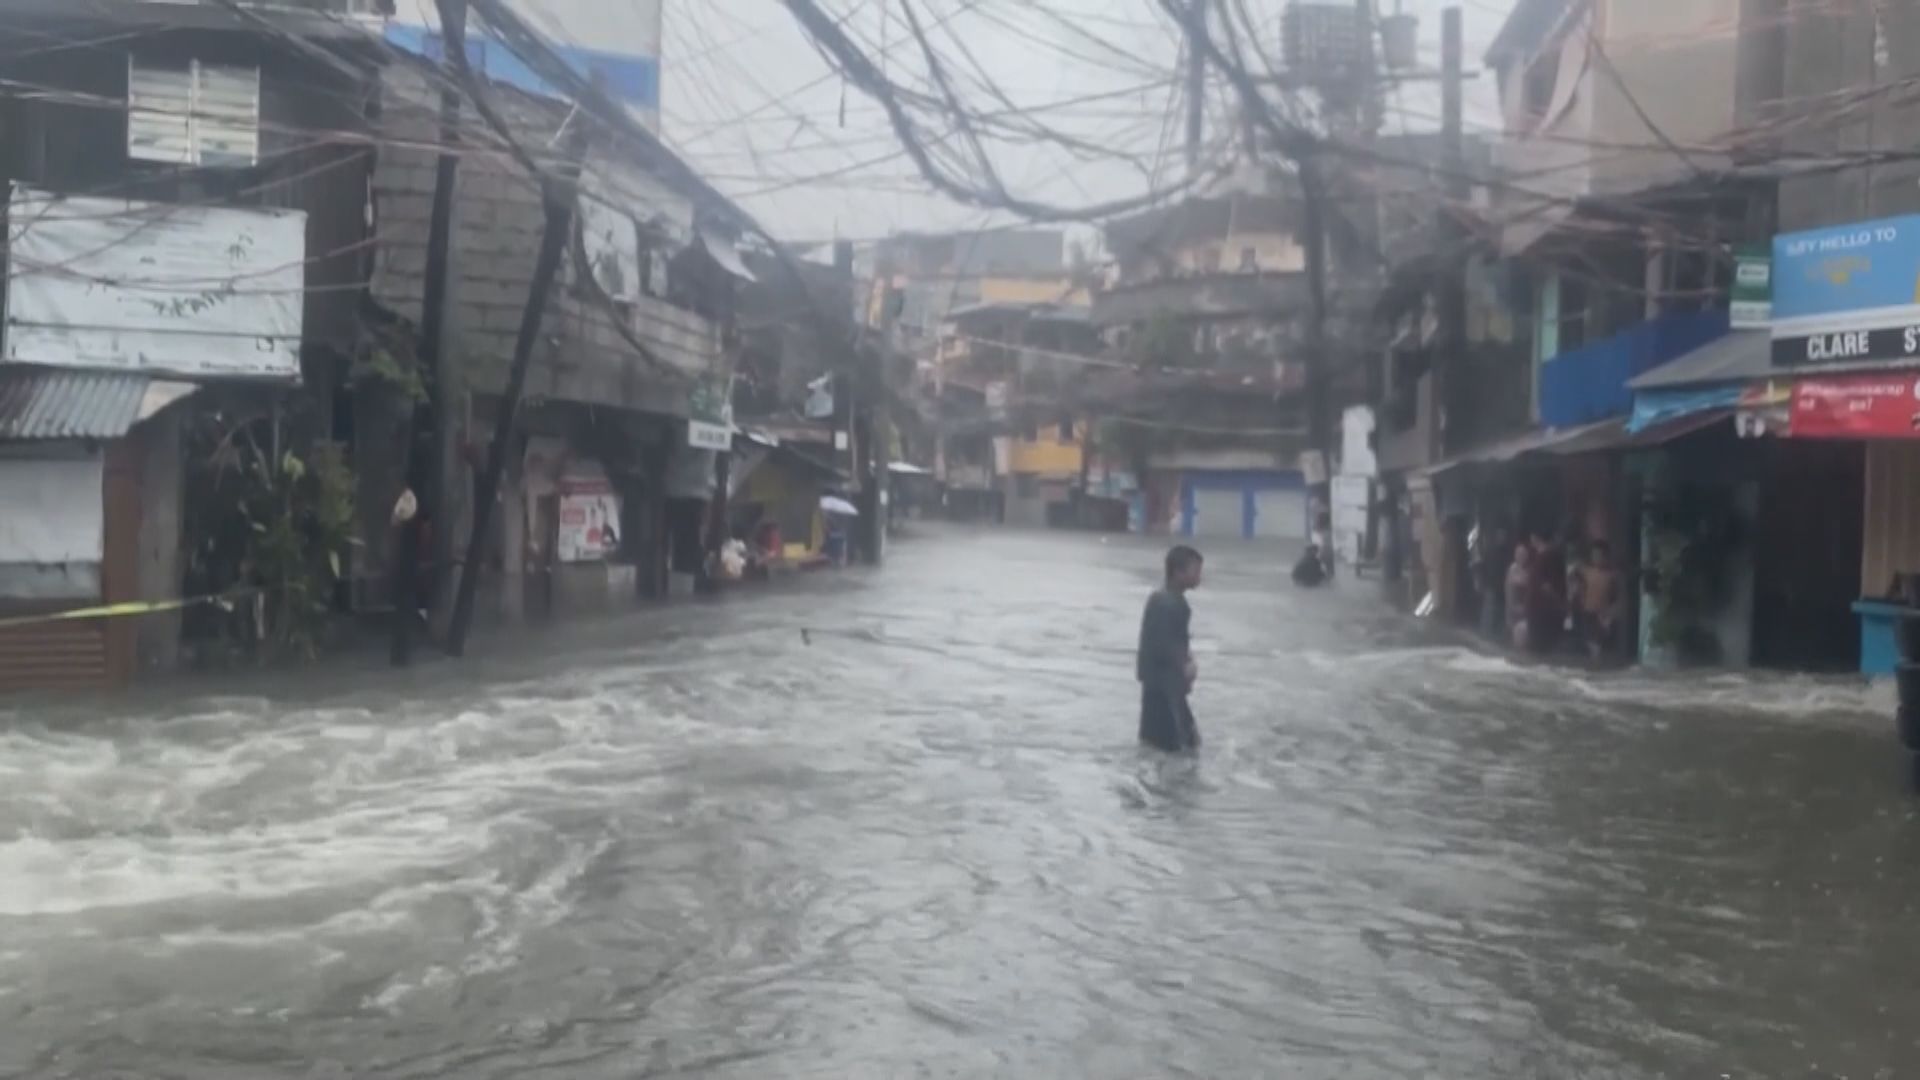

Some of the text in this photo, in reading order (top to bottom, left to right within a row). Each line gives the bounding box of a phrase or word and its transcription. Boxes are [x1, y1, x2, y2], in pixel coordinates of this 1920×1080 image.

[1819, 231, 1871, 251] HELLO
[1874, 226, 1897, 242] TO
[1807, 327, 1920, 360] CLARE S
